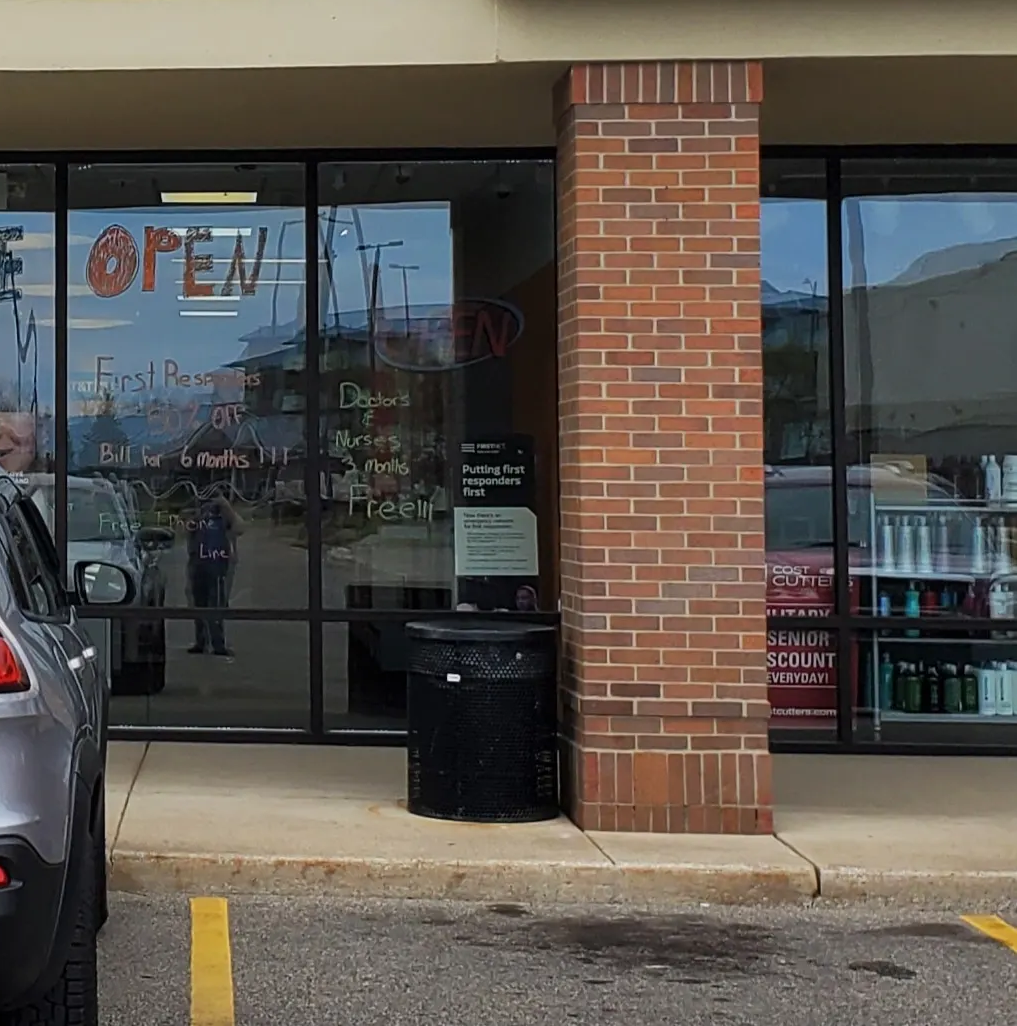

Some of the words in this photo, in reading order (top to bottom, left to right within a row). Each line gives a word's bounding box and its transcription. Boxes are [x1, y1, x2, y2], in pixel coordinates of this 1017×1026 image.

[86, 224, 268, 298] OPEN
[95, 355, 155, 394] First
[335, 430, 402, 449] Nurses
[341, 457, 357, 474] 3
[462, 464, 502, 475] Putting
[503, 464, 526, 474] first
[462, 476, 522, 487] responders
[463, 487, 486, 497] first
[772, 565, 811, 575] COST
[767, 630, 830, 646] SENIOR
[767, 651, 837, 668] SCOUNT
